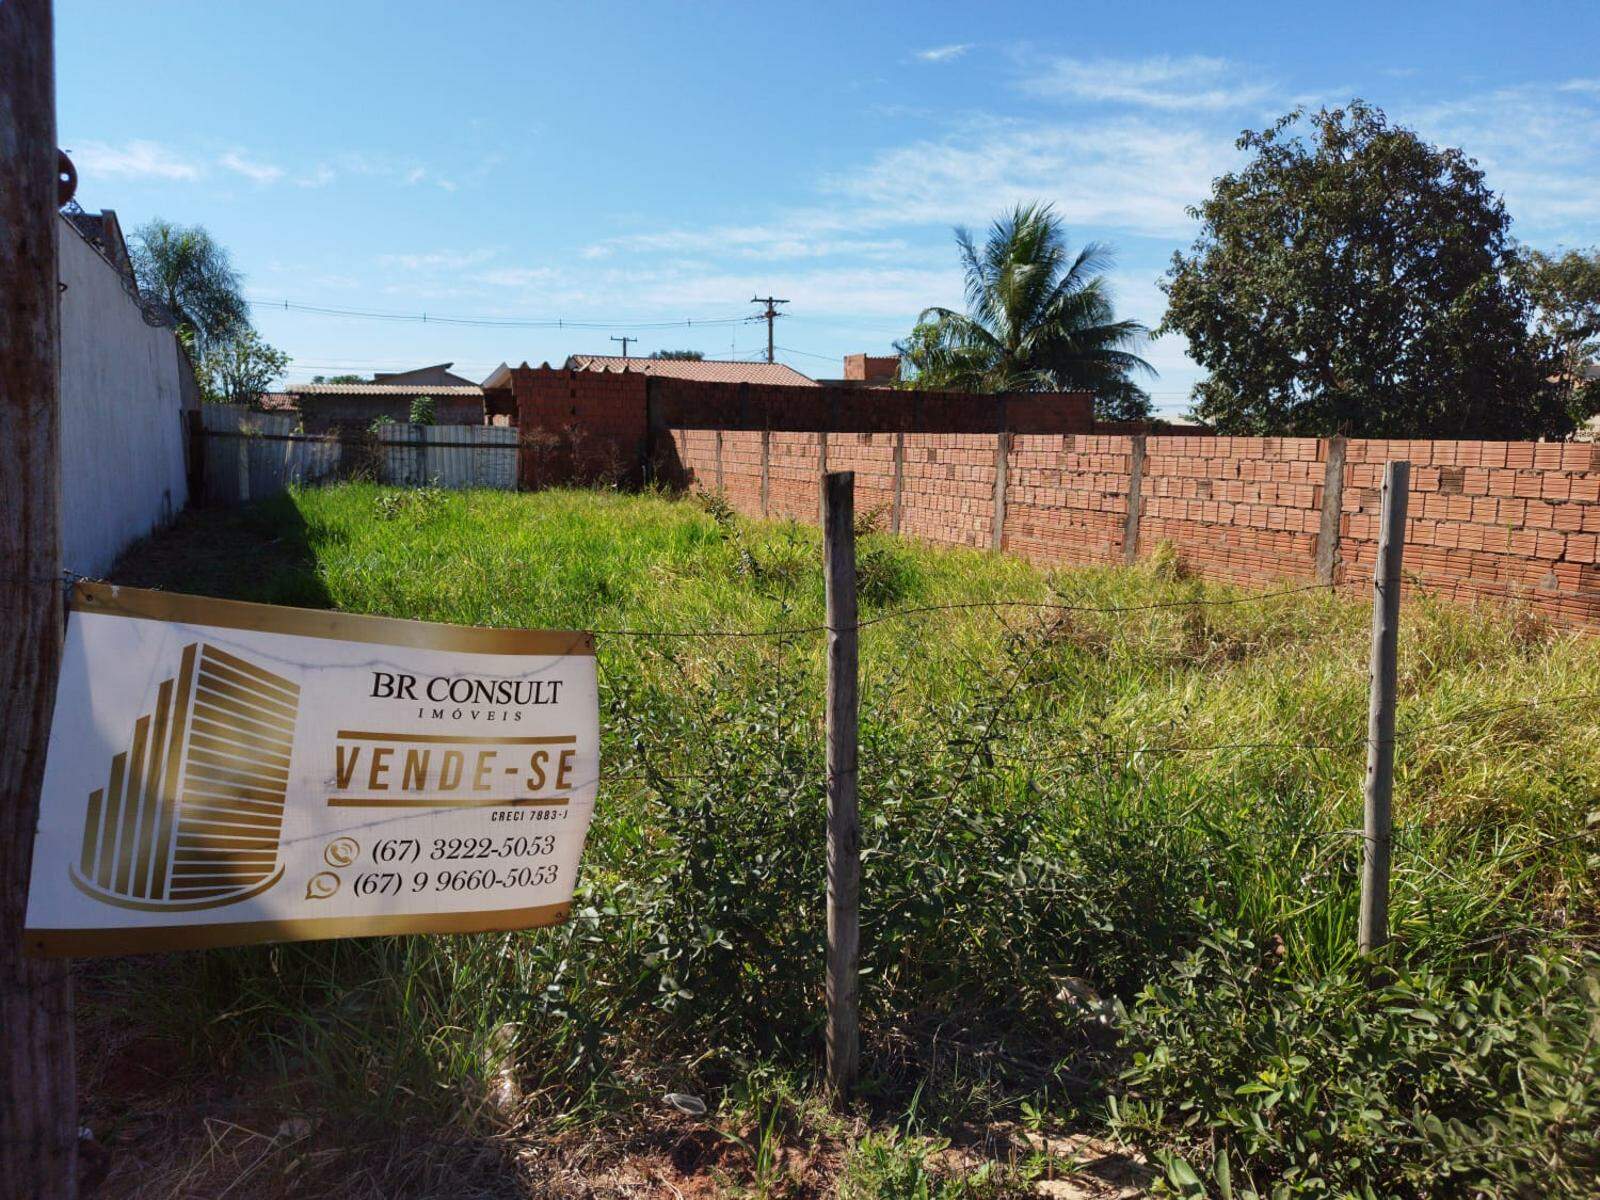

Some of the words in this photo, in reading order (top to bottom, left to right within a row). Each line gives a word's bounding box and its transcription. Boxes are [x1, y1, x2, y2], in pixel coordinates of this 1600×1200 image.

[370, 672, 418, 700] BR
[427, 677, 563, 705] CONSULT
[418, 708, 522, 721] IMÓVEIS
[336, 746, 576, 791] VENDE-SE
[491, 811, 524, 822] CRECI
[372, 839, 421, 864] (67)
[430, 835, 555, 860] 3222-5053
[353, 872, 402, 897] (67)
[412, 871, 429, 893] 9
[436, 865, 558, 891] 9660-5053
